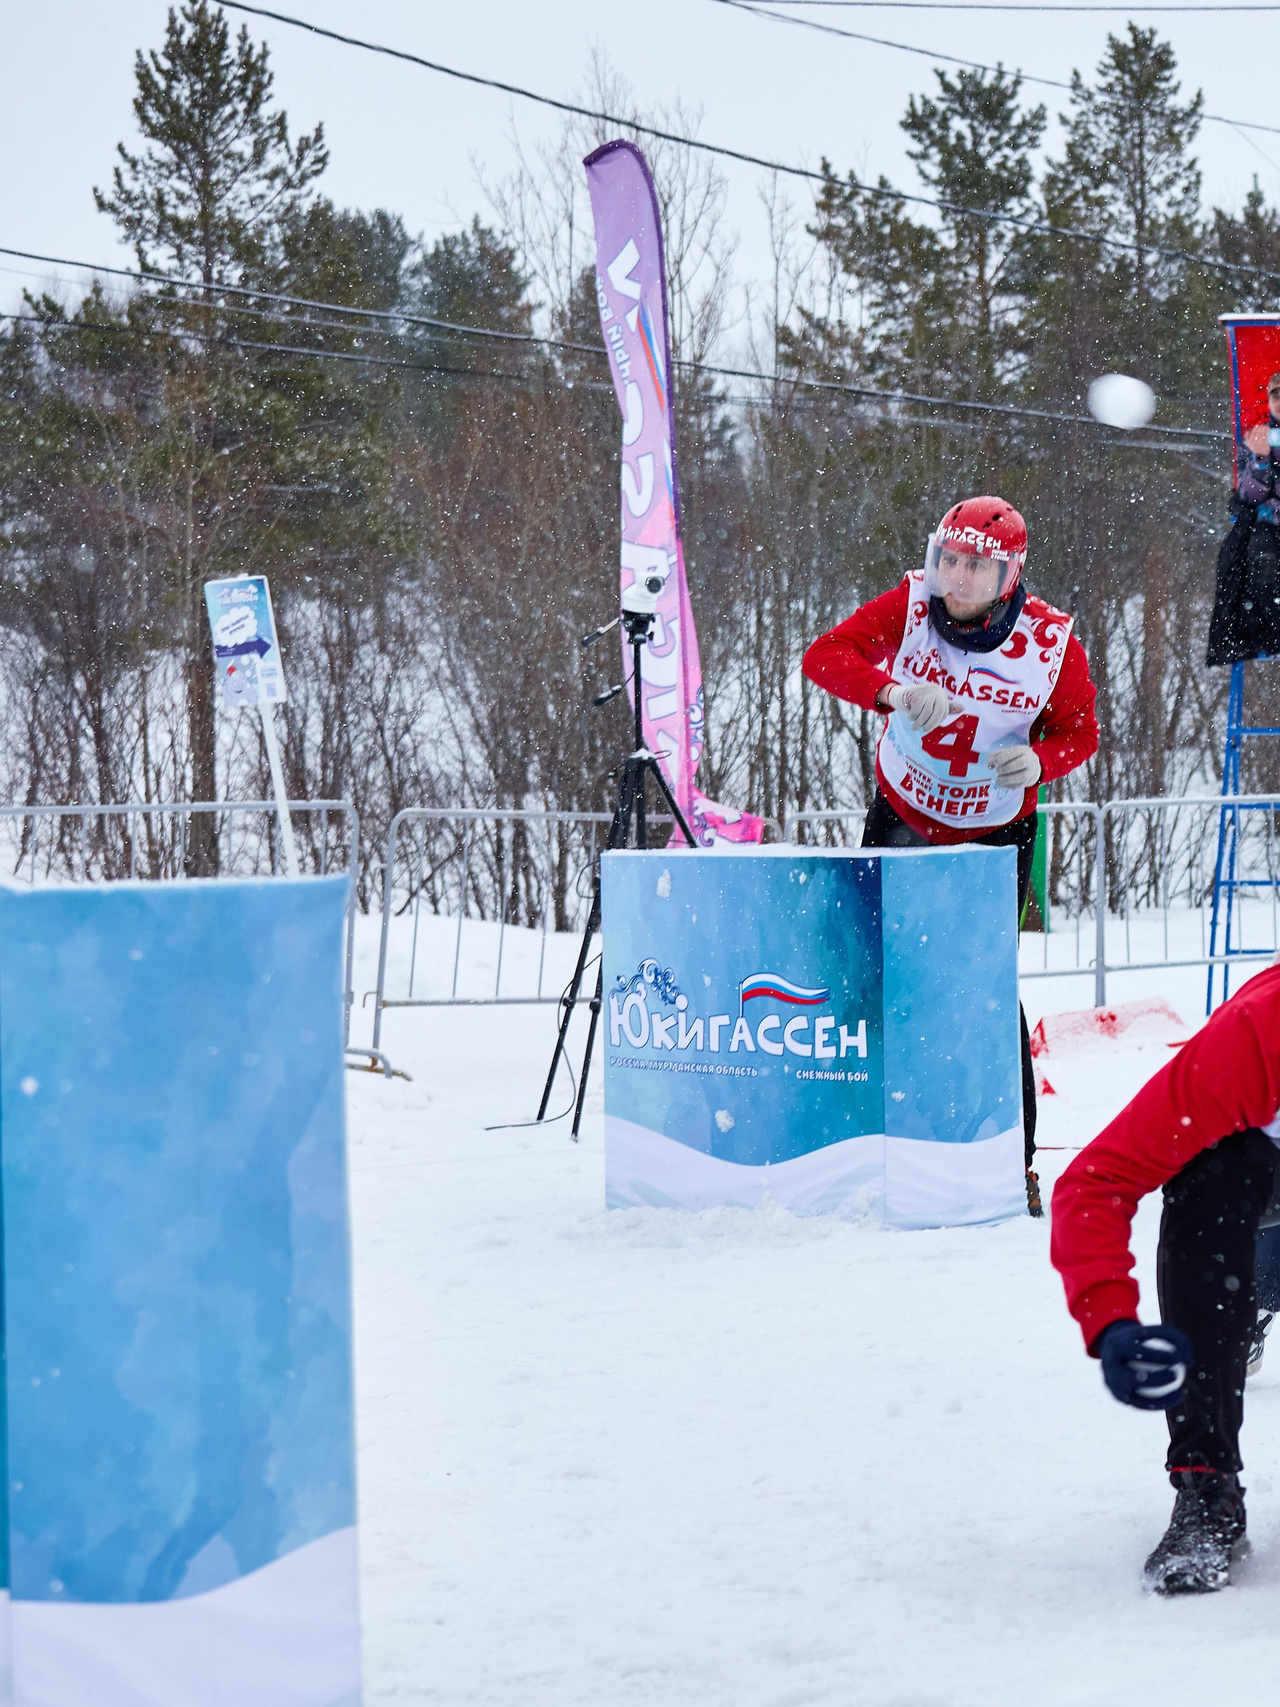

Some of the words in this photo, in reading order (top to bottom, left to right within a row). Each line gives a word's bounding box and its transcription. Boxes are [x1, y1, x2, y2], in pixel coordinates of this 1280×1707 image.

[902, 656, 1041, 710] YUKIGASSEN
[921, 713, 980, 778] 4
[915, 788, 990, 817] СНЕГЕ
[937, 783, 992, 800] ТОЛК
[609, 984, 869, 1060] ЮКИГАССЕН
[609, 1056, 648, 1071] РОССИЯ,
[648, 1059, 715, 1076] МУРМАНСКАЯ
[715, 1063, 759, 1079] ОБЛАСТЬ
[795, 1067, 846, 1082] СНЕЖНЫЙ
[846, 1068, 869, 1084] БОЙ
